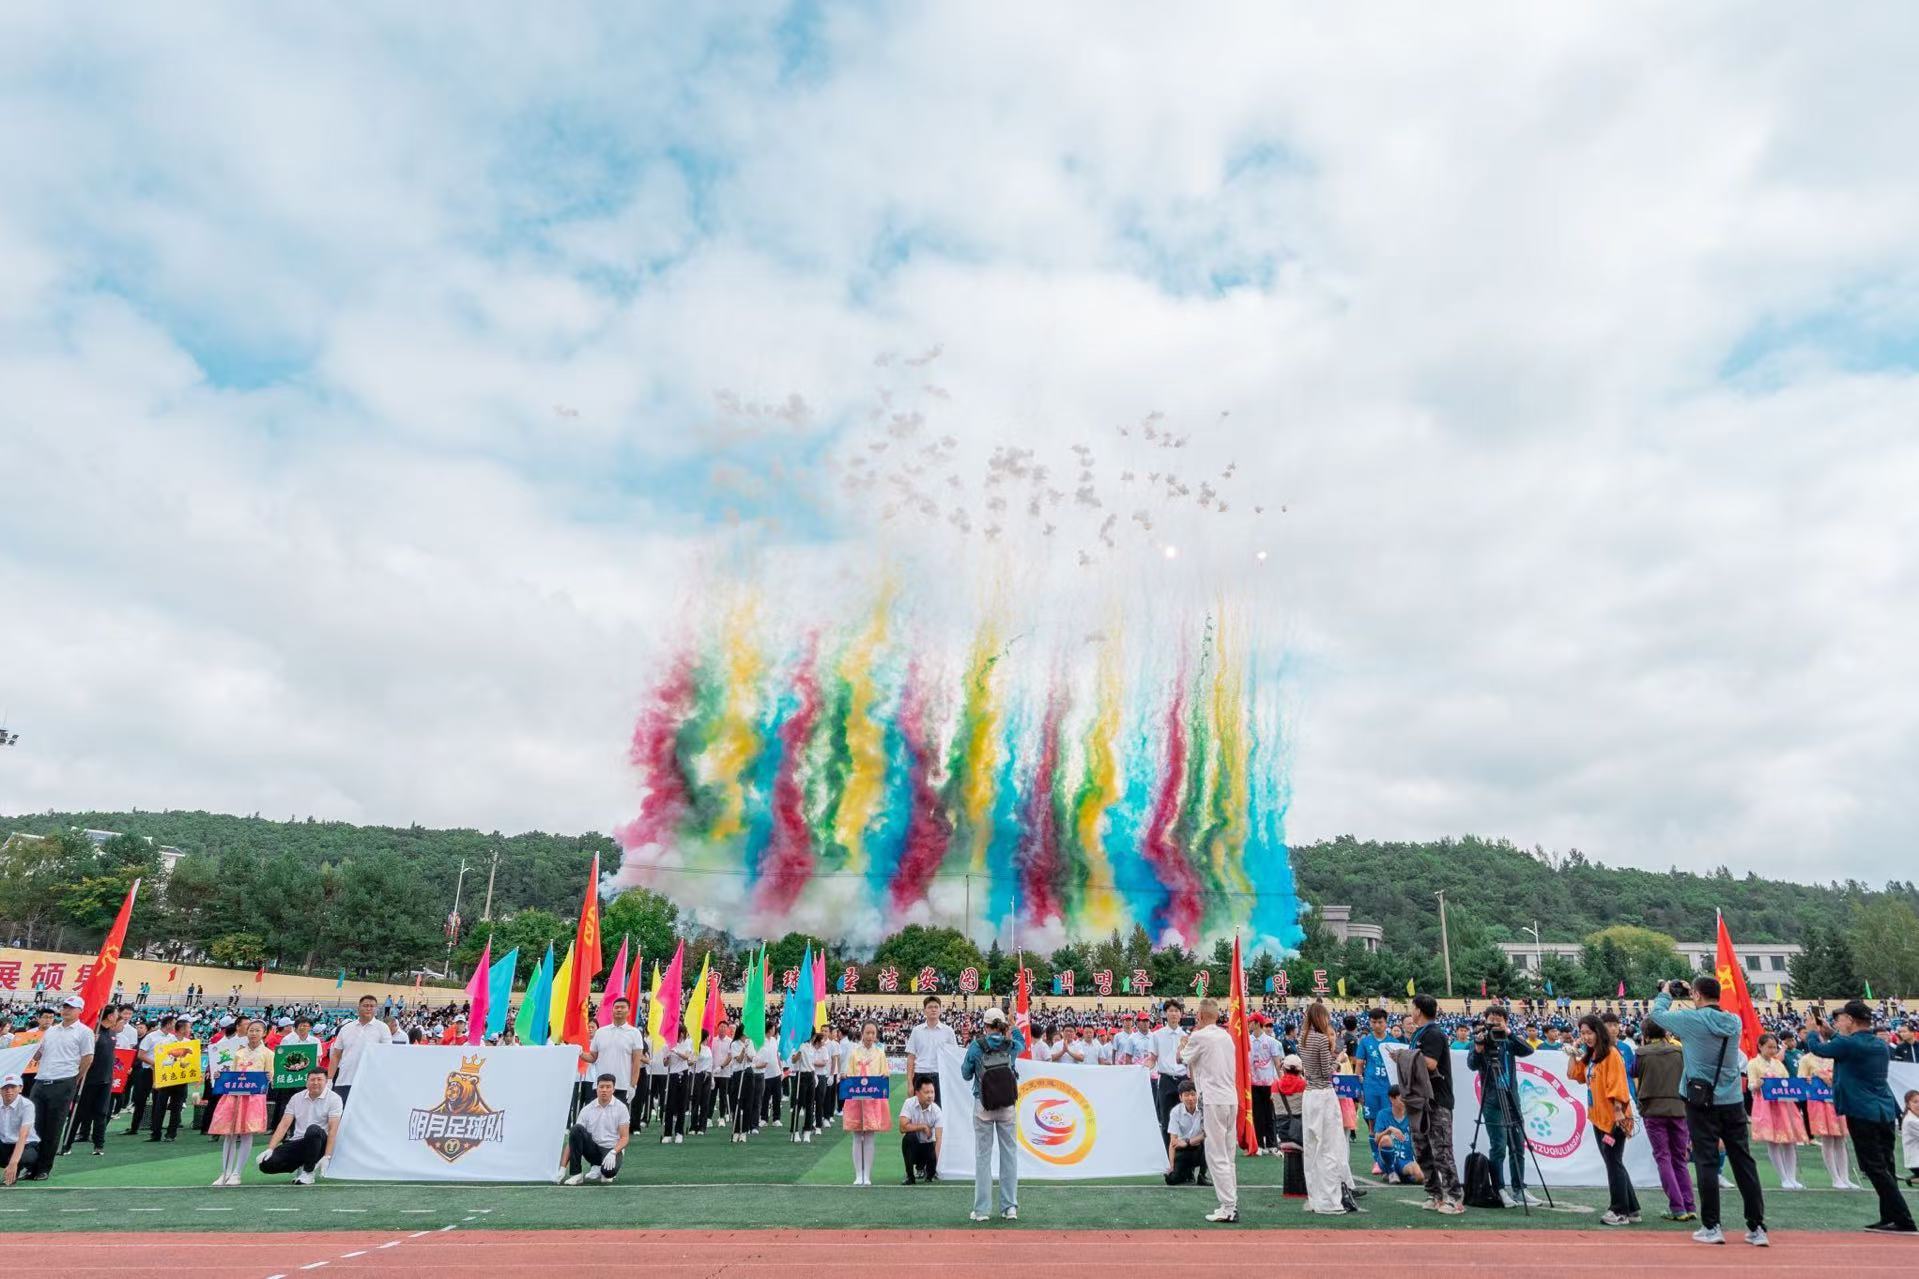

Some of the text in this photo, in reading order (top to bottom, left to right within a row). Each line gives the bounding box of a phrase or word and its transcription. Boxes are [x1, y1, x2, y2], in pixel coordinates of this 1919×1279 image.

[1375, 1066, 1387, 1077] 35
[409, 1109, 504, 1141] 明月足球队
